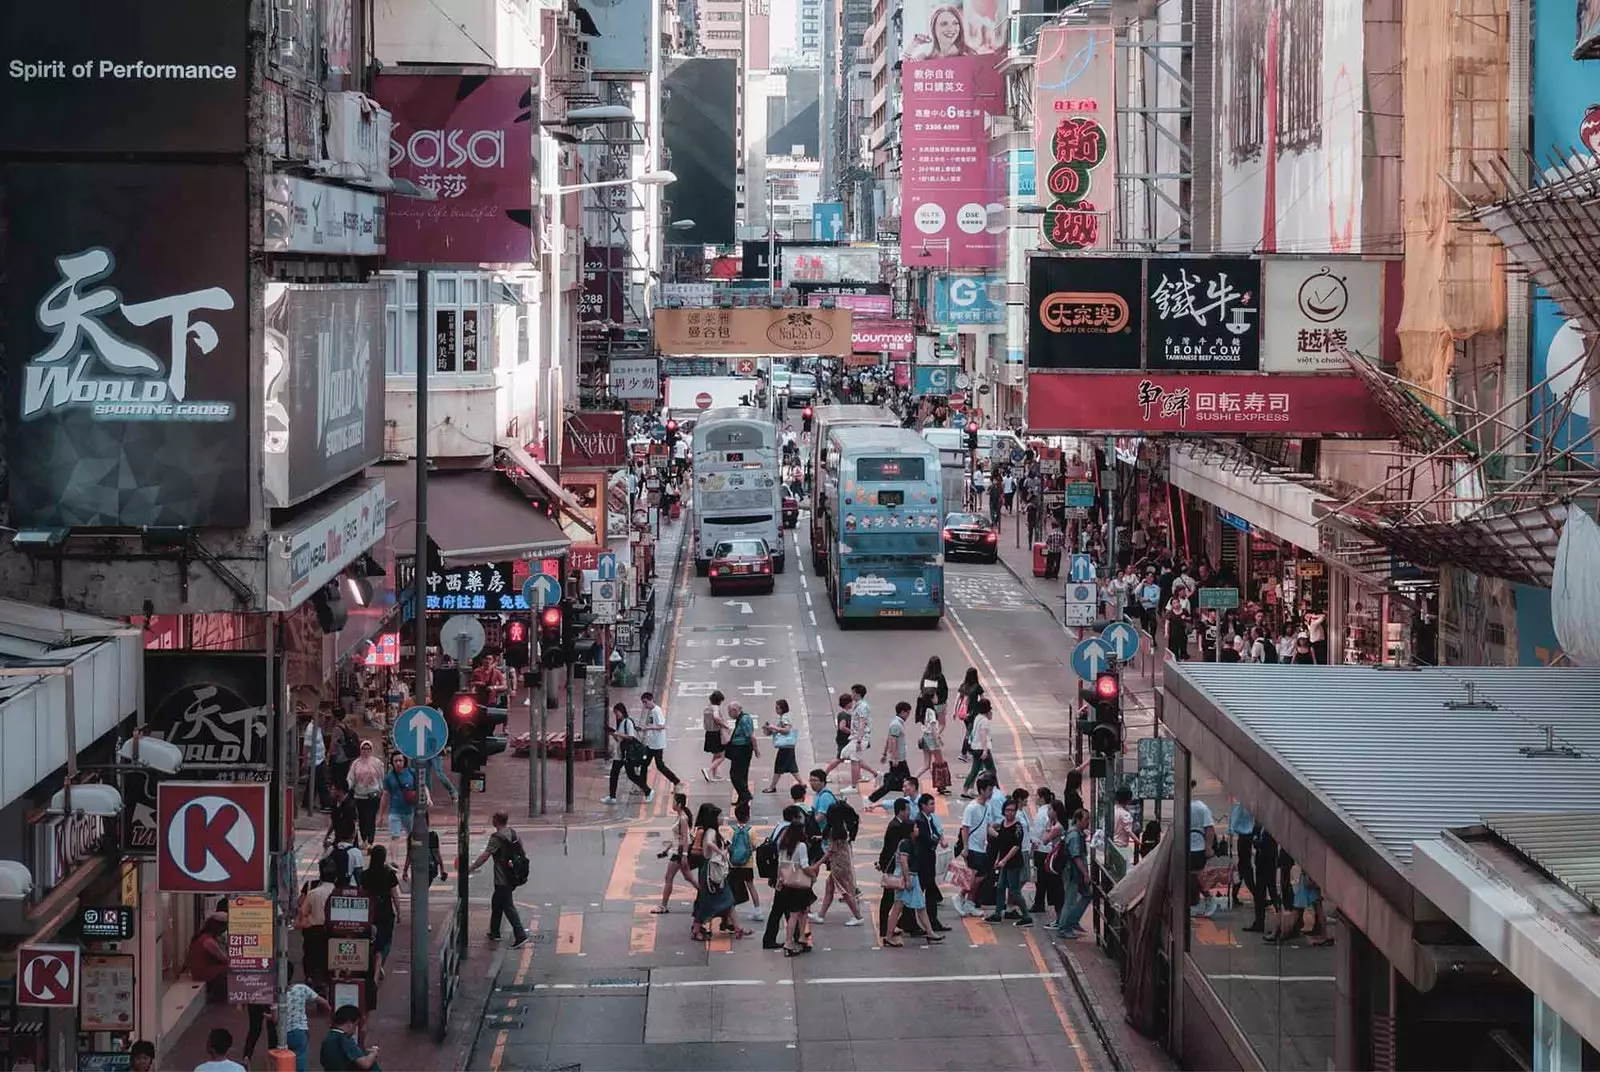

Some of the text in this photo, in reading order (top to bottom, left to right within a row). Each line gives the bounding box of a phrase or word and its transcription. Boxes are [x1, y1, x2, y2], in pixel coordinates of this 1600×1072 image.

[9, 60, 237, 82] Spirit of Performance
[914, 69, 954, 79] 教你自信
[914, 82, 964, 92] 開口講英文
[1150, 268, 1241, 327] 鐵牛
[34, 249, 235, 402] 天下
[687, 326, 731, 339] 曼谷包
[1165, 345, 1241, 355] IRON COW
[1195, 392, 1290, 413] 回転寿司
[176, 404, 231, 416] GOODS
[1195, 413, 1290, 422] SUSHI EXPRESS
[426, 571, 506, 593] 中西藥房
[686, 637, 766, 648] BUS
[674, 655, 780, 669] STOP
[677, 680, 777, 697] 巴士
[183, 686, 274, 761] 天下
[230, 935, 242, 945] E21
